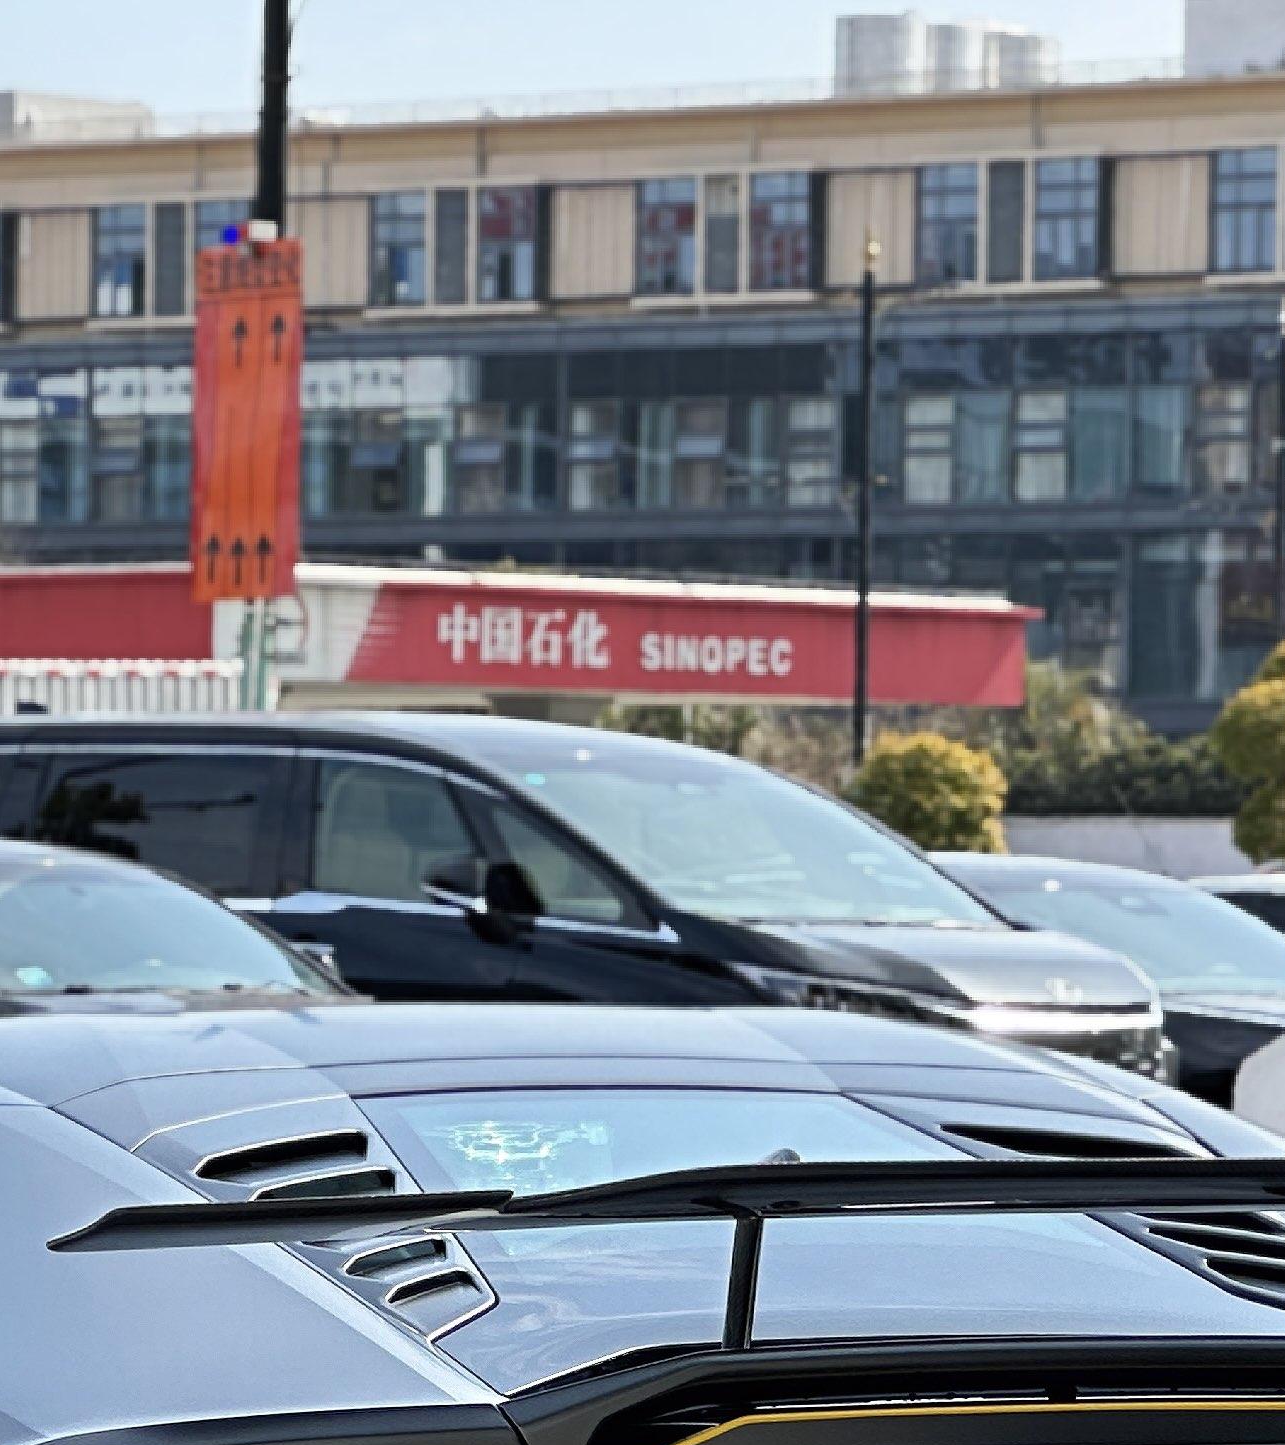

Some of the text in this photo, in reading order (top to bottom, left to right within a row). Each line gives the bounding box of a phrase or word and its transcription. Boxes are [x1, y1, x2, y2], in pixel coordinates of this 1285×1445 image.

[437, 602, 793, 677] 中国石化 SINOPEC
